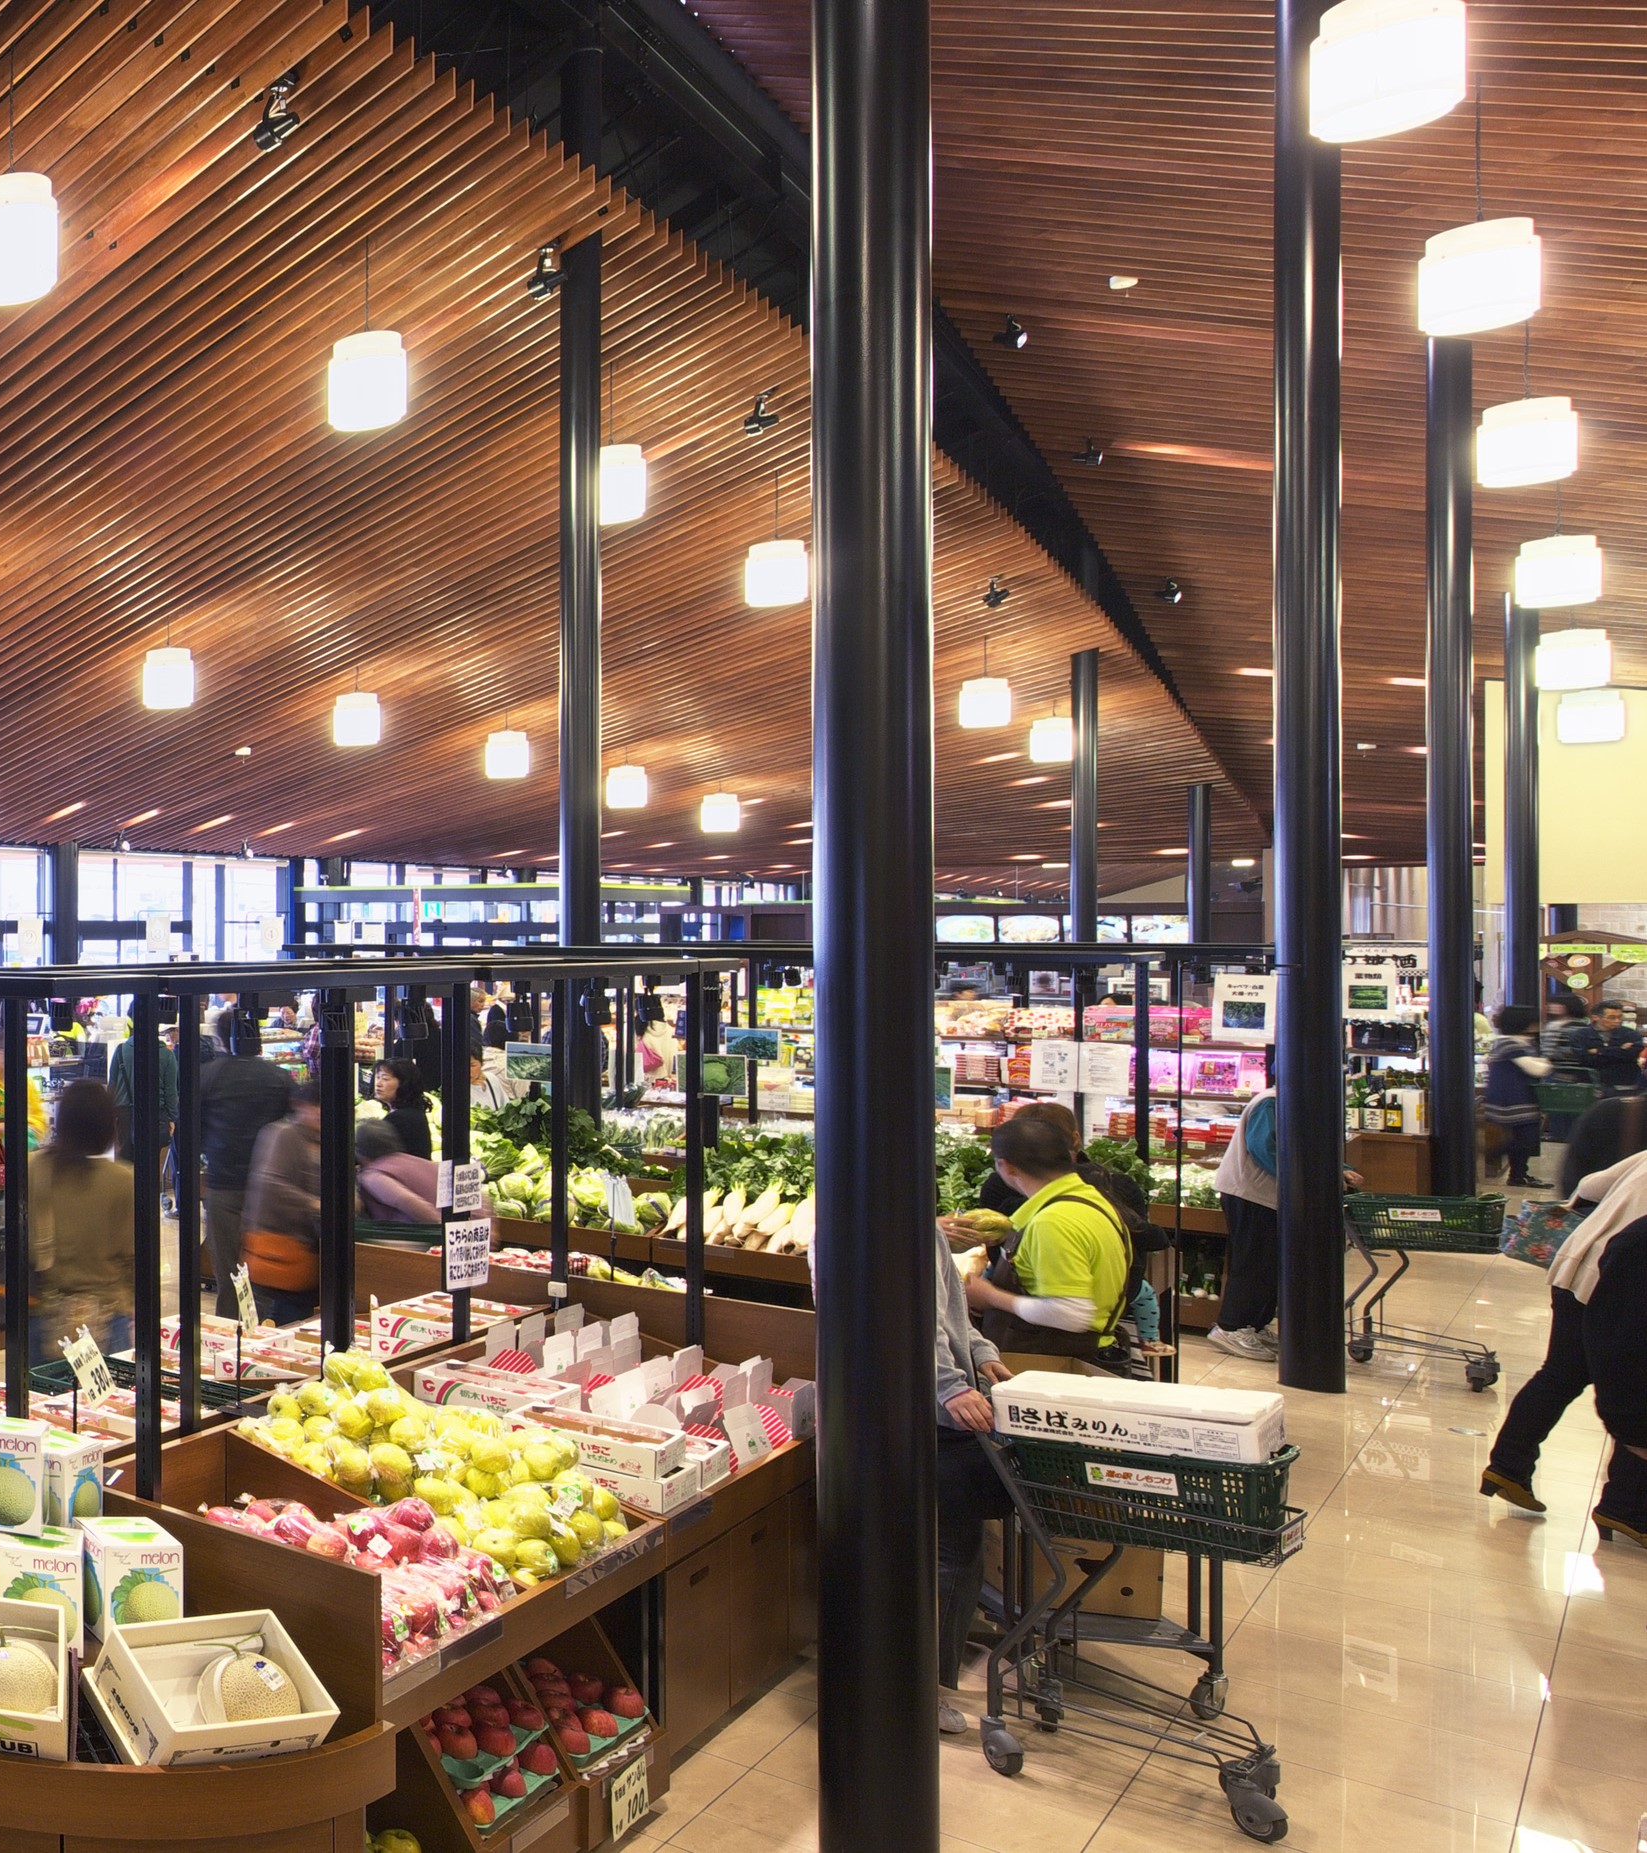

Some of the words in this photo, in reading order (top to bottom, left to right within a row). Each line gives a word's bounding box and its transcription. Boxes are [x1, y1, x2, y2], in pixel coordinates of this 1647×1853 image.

[449, 1225, 490, 1246] こちらの商品は
[459, 1389, 508, 1407] 栃木いちご
[1021, 1407, 1129, 1437] さばみりん
[82, 1449, 102, 1467] melon
[33, 1557, 77, 1574] melon
[140, 1551, 180, 1565] melon
